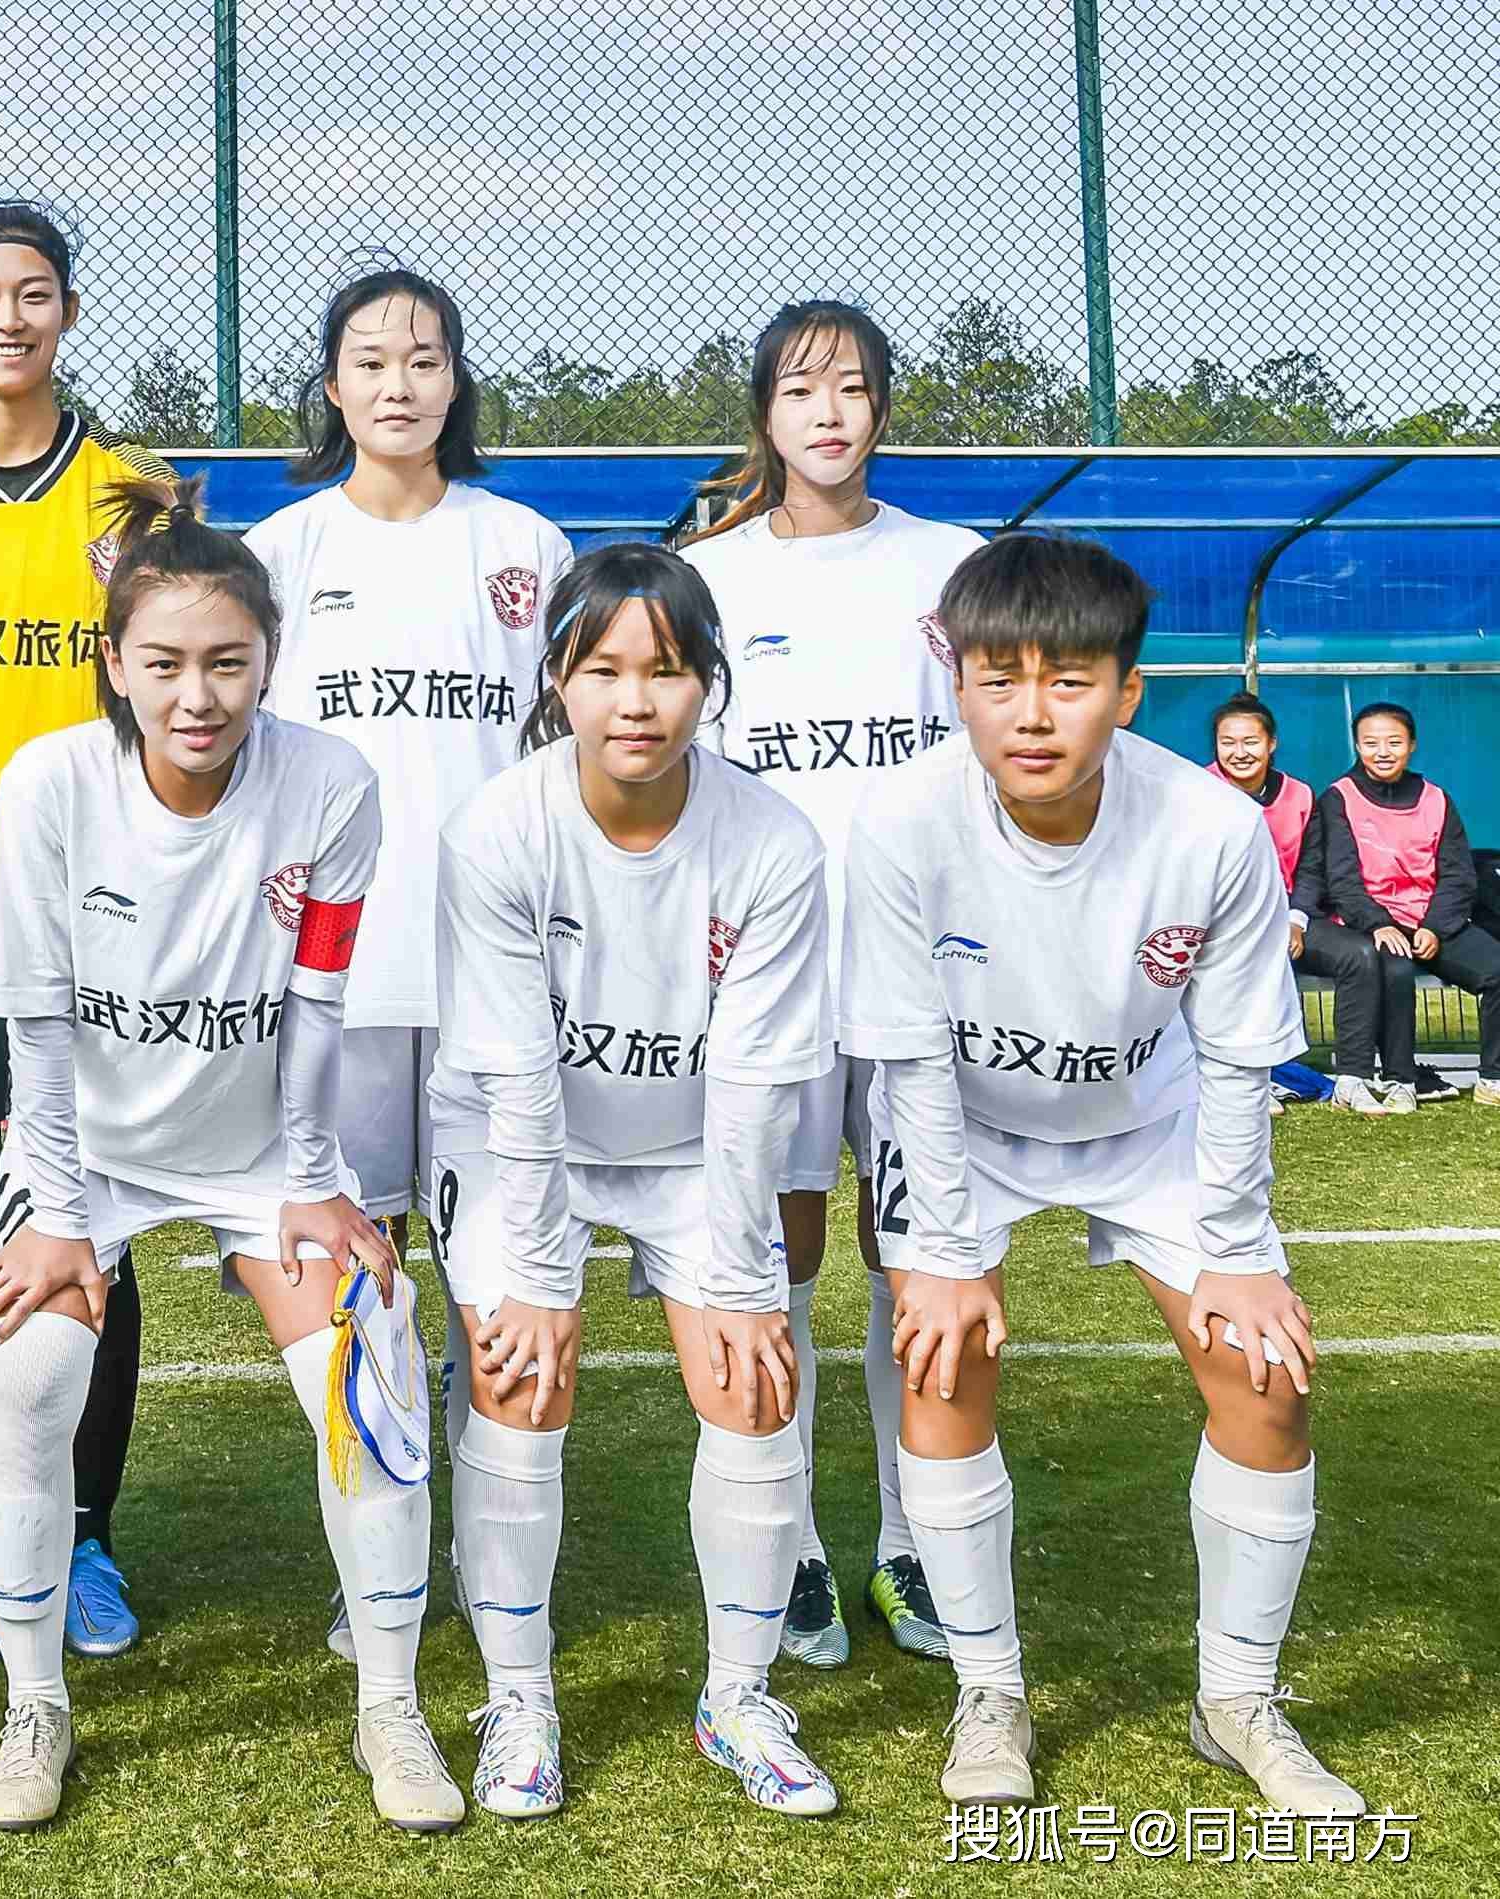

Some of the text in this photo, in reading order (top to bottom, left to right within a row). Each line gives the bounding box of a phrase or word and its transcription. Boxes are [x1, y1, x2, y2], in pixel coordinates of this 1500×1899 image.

[310, 601, 355, 616] LI-NING
[316, 667, 516, 727] 武汉旅体
[81, 901, 138, 924] LI-NING
[931, 949, 989, 965] LI-NING
[875, 1140, 910, 1236] 12
